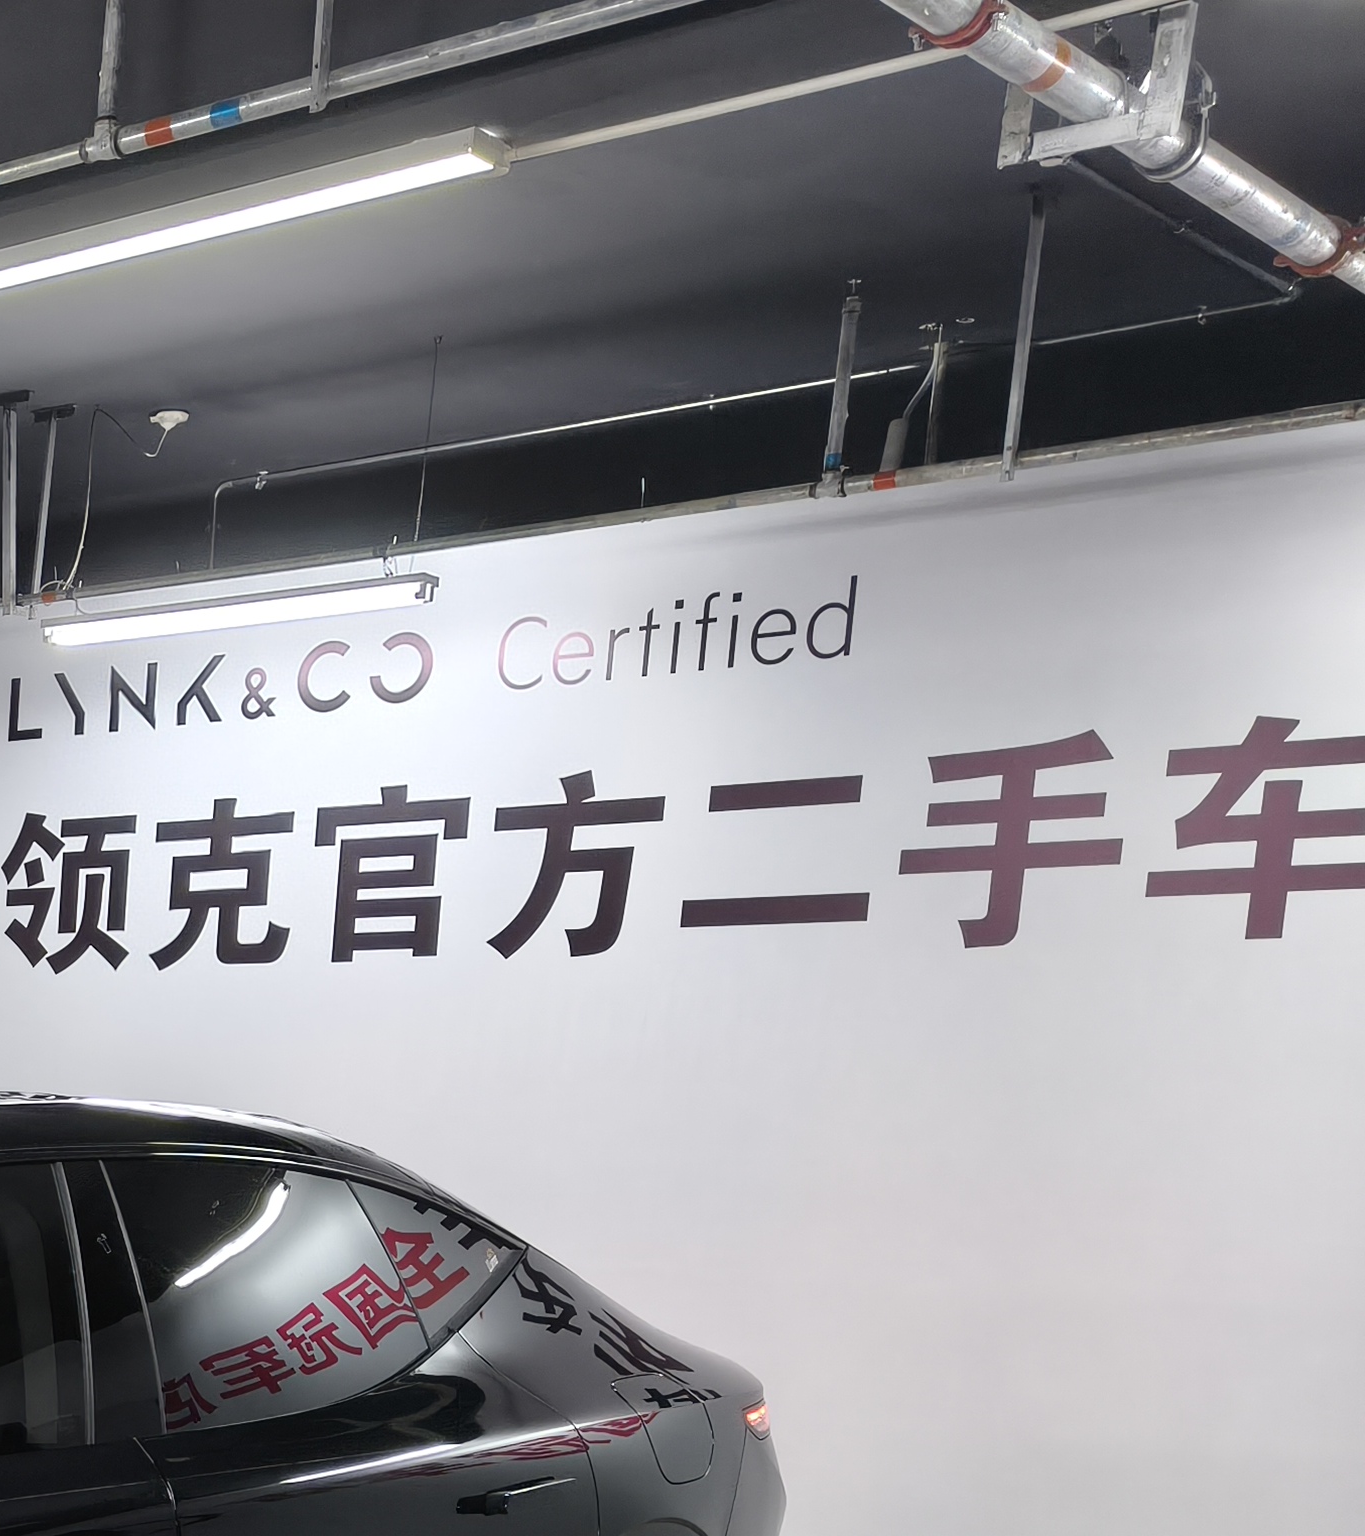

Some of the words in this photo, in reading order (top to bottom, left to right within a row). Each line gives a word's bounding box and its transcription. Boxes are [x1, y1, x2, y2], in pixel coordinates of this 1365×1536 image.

[497, 575, 859, 691] Certified
[0, 714, 1365, 975] 领克官方二手车
